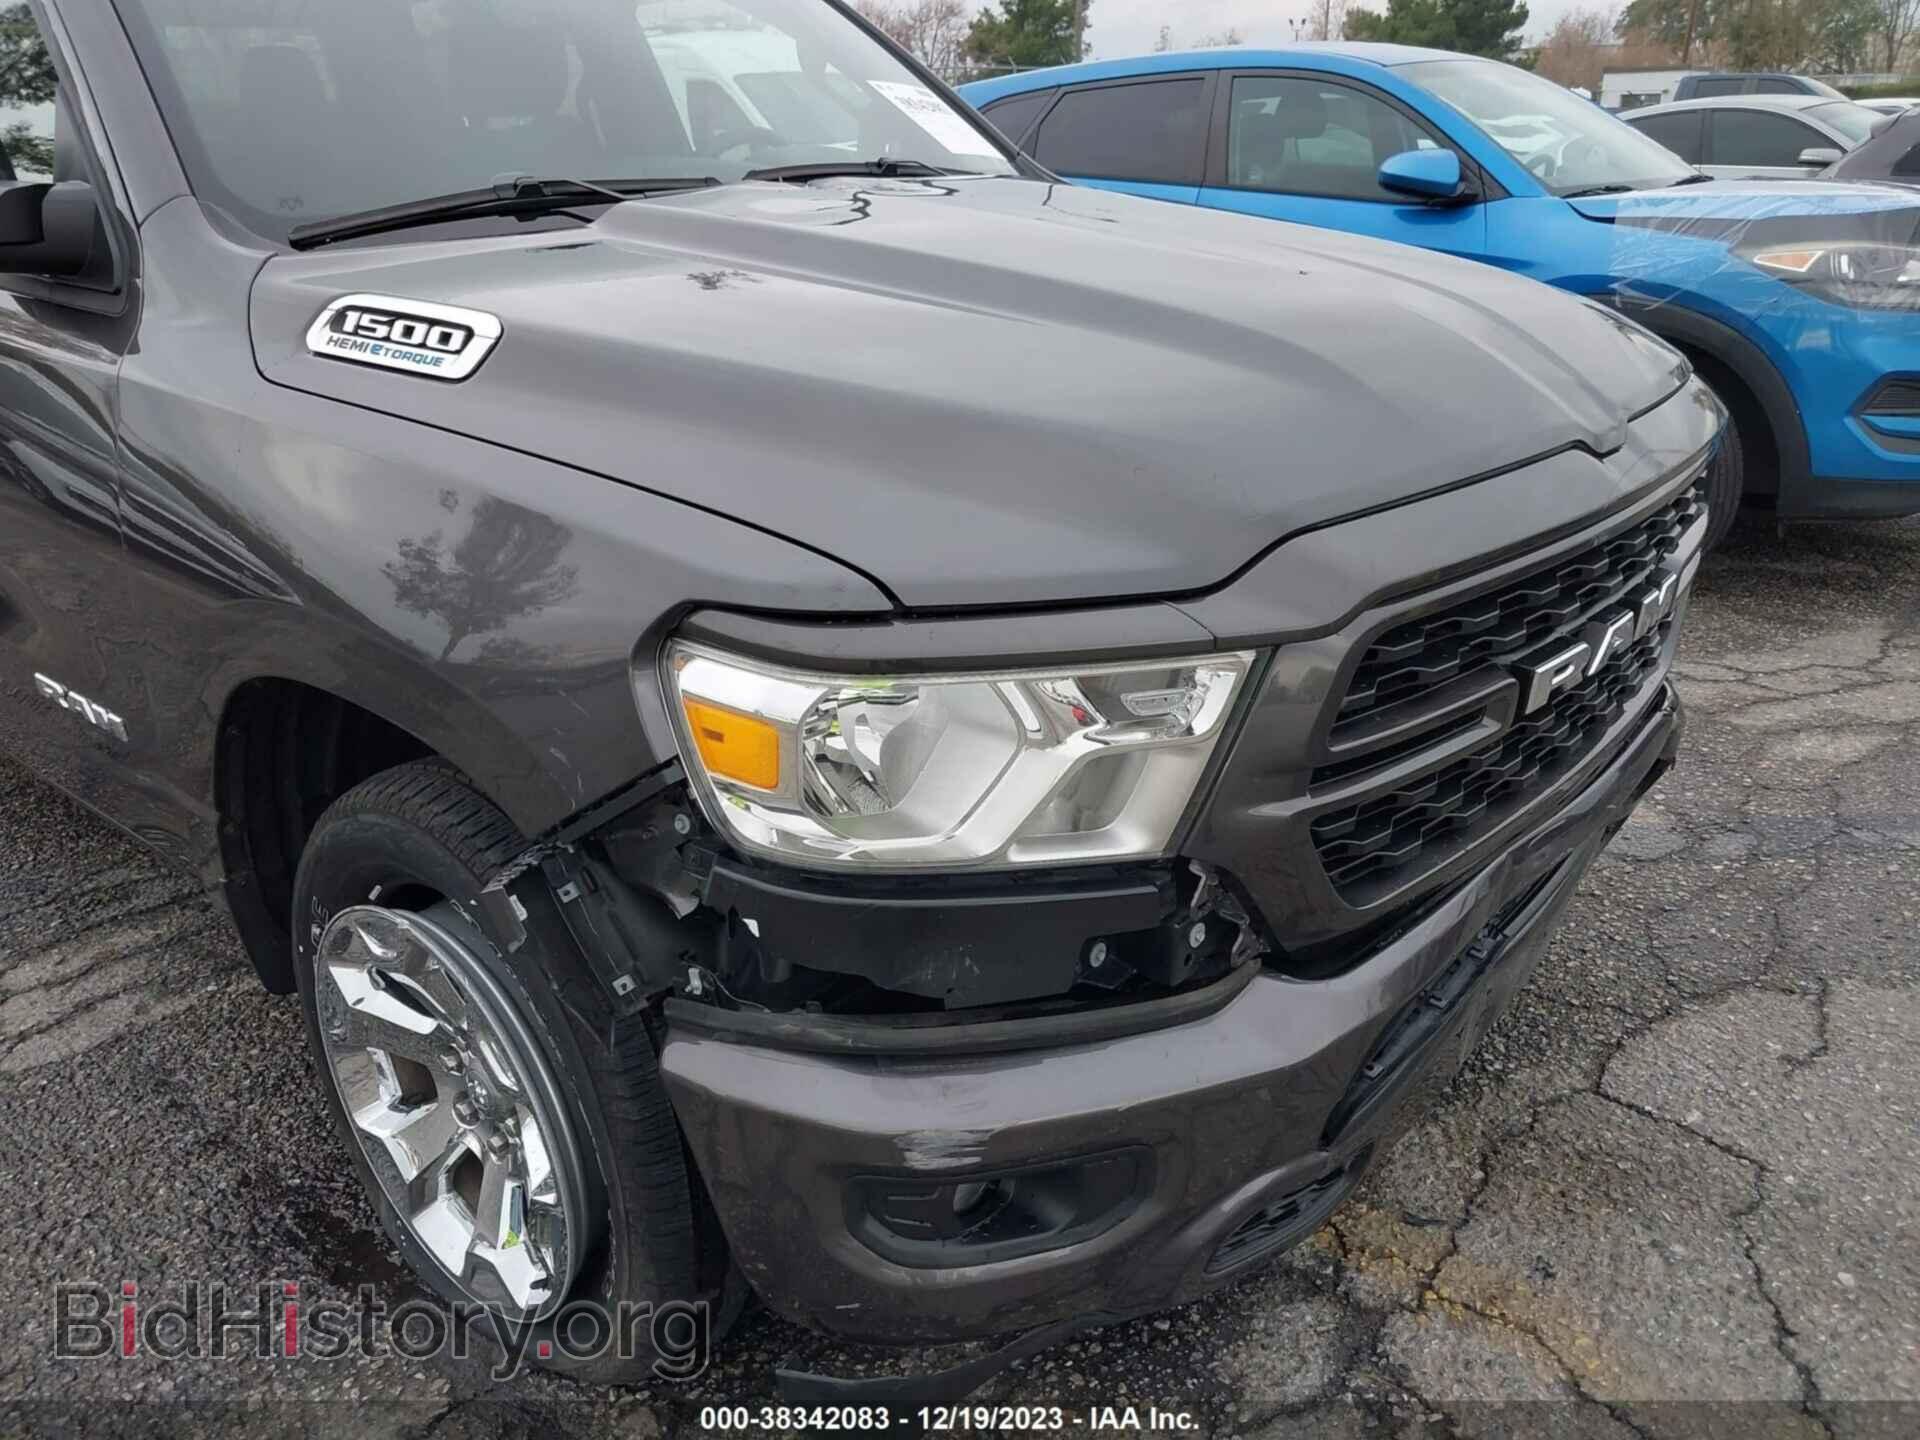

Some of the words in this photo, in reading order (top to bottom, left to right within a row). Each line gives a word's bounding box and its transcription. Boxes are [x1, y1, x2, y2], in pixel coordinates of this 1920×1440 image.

[326, 335, 369, 353] HEMI
[342, 310, 467, 352] 1500
[1525, 573, 1678, 715] RAM
